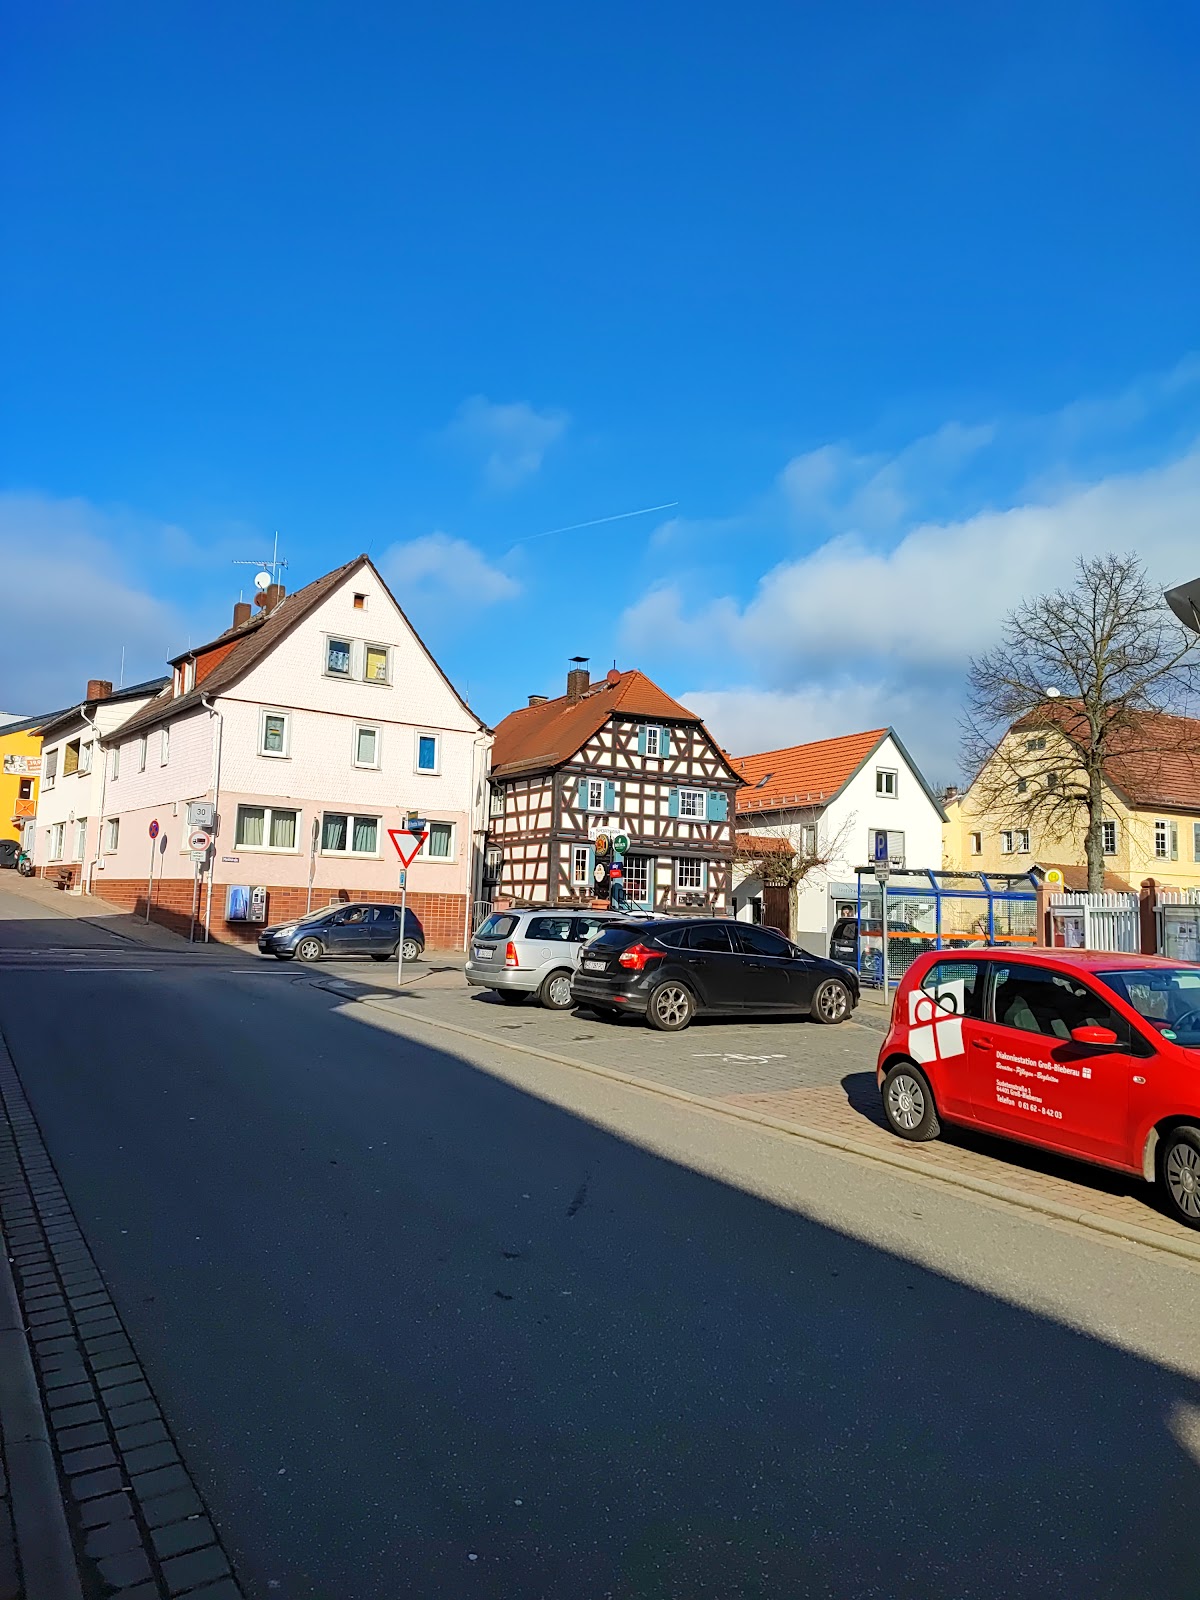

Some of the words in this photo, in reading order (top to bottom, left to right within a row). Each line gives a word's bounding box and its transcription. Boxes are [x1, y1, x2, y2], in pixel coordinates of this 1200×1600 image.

[877, 834, 885, 857] P
[996, 1050, 1037, 1067] Diakoniestation
[1037, 1060, 1080, 1077] Groß-Bieberau
[996, 1094, 1015, 1106] Telefon
[1029, 1103, 1037, 1112] 62
[1010, 1089, 1042, 1103] Groß-Bieberau
